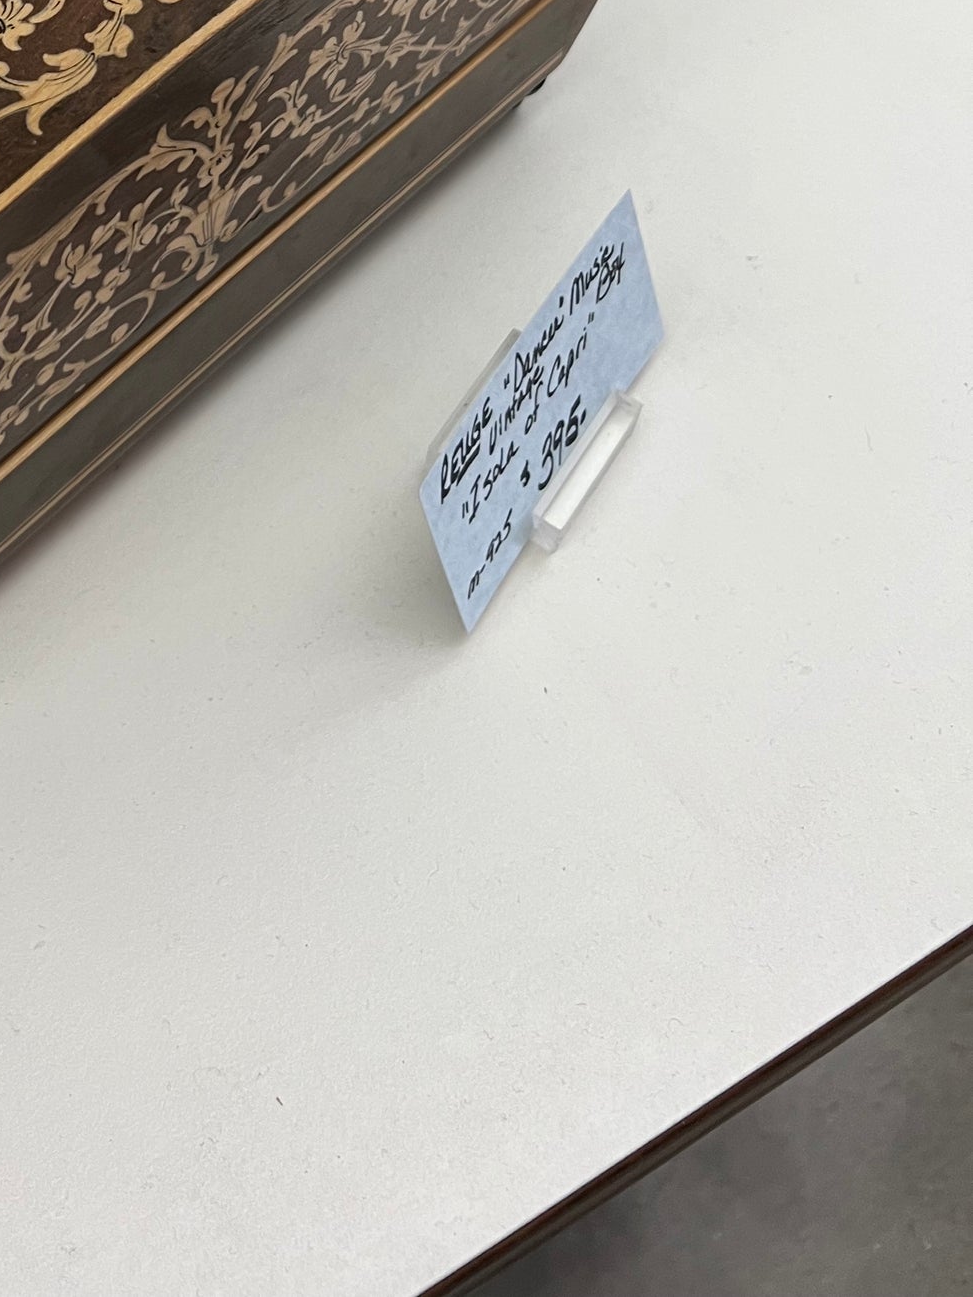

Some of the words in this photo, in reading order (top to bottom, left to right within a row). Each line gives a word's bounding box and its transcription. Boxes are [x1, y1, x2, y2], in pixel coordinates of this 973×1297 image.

[440, 396, 494, 505] REUGE
[569, 243, 615, 316] Music
[524, 379, 544, 435] of
